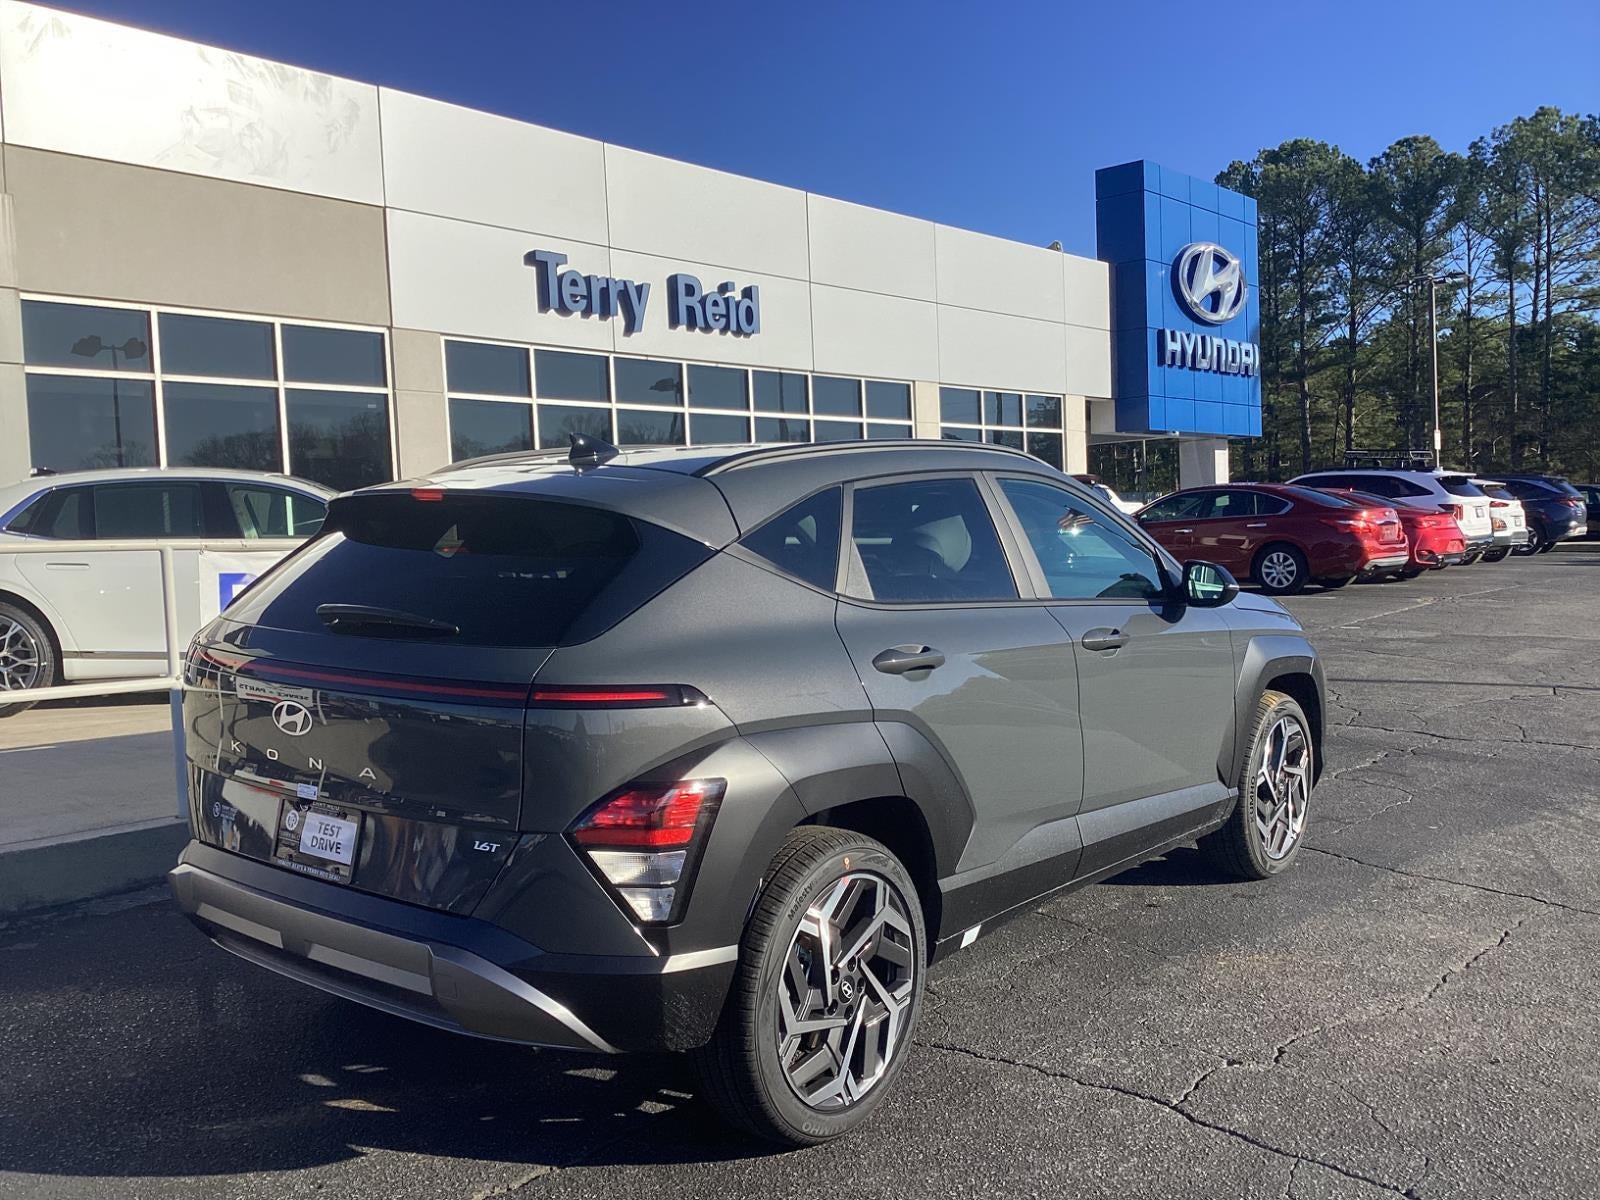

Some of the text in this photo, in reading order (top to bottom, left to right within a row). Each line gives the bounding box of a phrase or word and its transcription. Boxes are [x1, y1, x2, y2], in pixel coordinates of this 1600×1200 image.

[524, 250, 760, 338] Terry Reid
[1158, 328, 1260, 377] HYUNDAI
[231, 740, 376, 780] KONA
[310, 835, 342, 855] DRIVE
[318, 821, 342, 838] TEST
